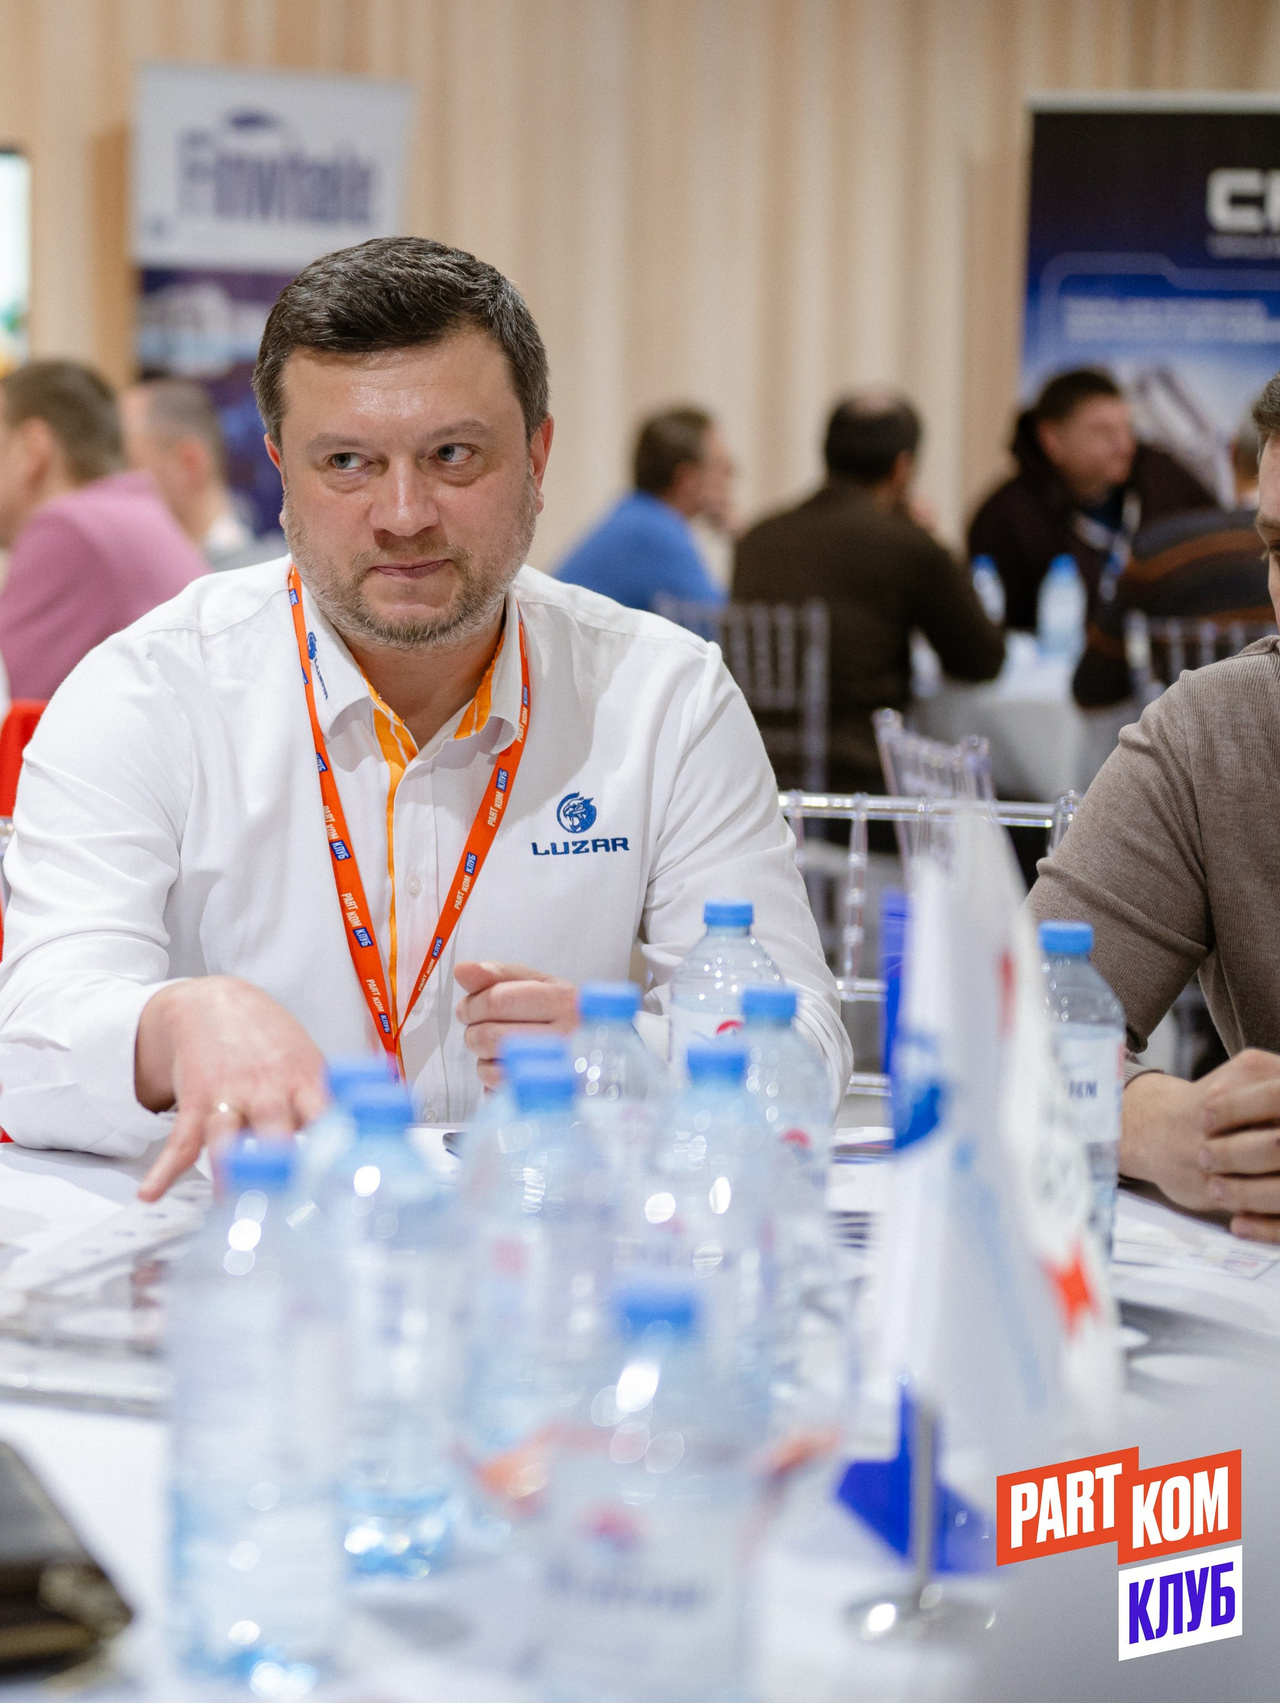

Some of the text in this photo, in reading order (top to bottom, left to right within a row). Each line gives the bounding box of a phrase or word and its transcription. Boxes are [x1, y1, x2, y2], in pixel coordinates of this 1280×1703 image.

[487, 771, 508, 827] PART KOM КЛУБ
[331, 841, 349, 860] КЛУБ
[531, 837, 630, 856] LUZAR
[454, 854, 477, 910] PART KOM КЛУБ
[341, 892, 372, 947] PART KOM КЛУБ
[366, 979, 380, 997] PART
[372, 996, 384, 1012] KOM
